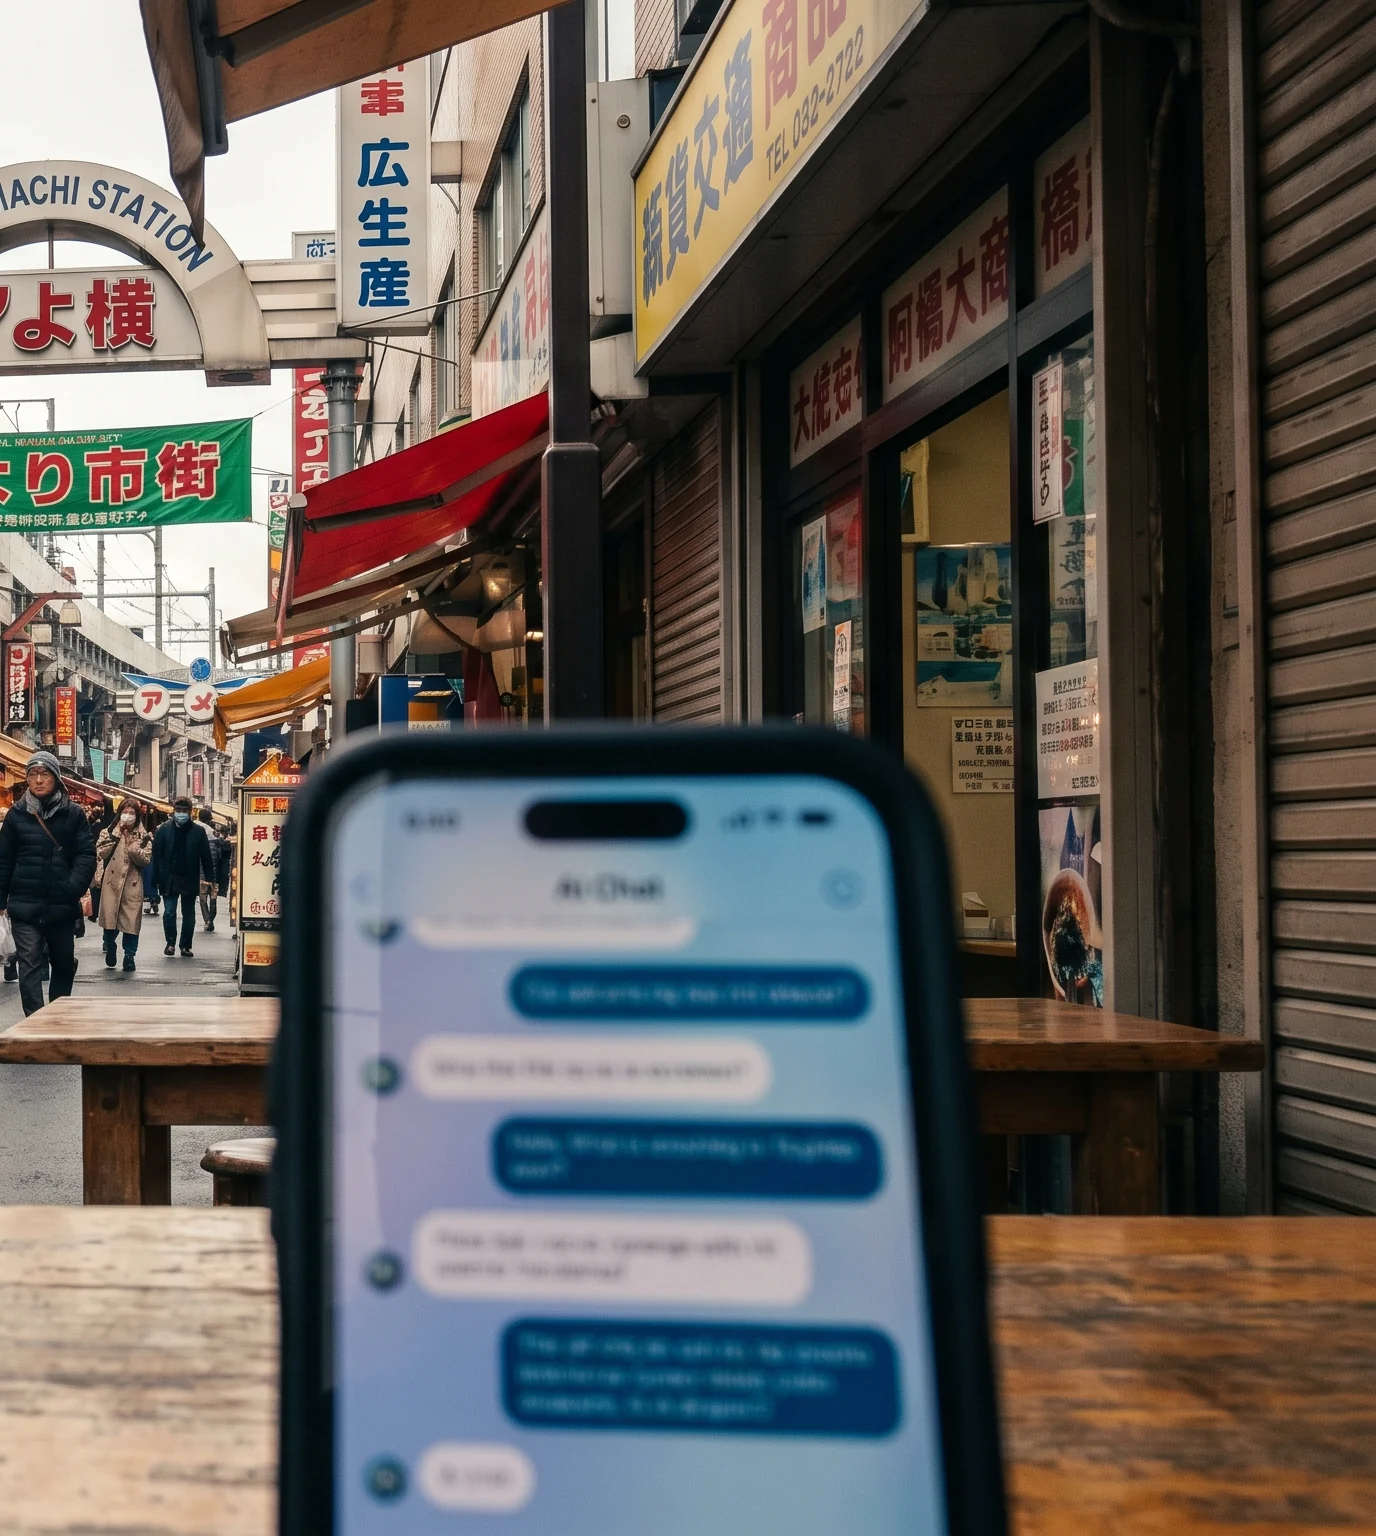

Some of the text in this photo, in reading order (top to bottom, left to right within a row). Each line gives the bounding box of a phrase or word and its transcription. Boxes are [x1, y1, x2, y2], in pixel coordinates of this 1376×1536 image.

[766, 128, 790, 181] TEL
[88, 179, 214, 273] STATION
[358, 137, 411, 308] 広生産
